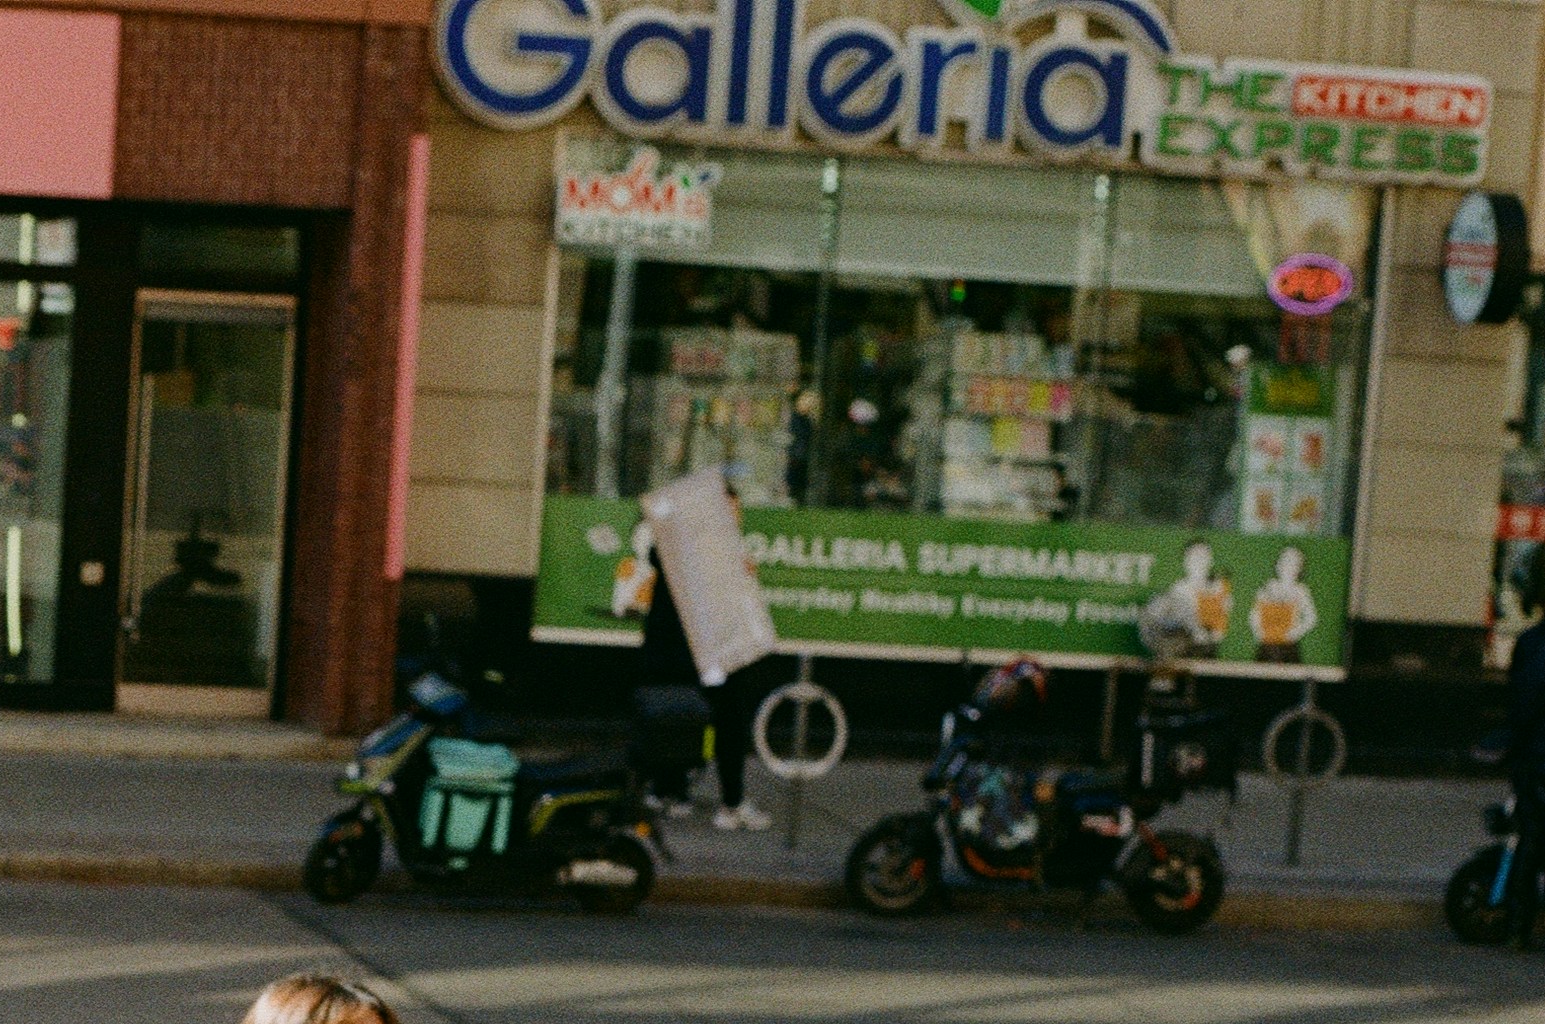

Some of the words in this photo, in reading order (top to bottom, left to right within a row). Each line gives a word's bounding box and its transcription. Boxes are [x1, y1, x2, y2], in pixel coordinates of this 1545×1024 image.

[446, 0, 1128, 147] Galleria
[1158, 61, 1285, 112] THE
[1297, 79, 1482, 123] KITCHEN
[1157, 113, 1480, 174] EXPRESS
[743, 530, 909, 572] GALLERIA
[917, 541, 1152, 586] SUPERMARKET
